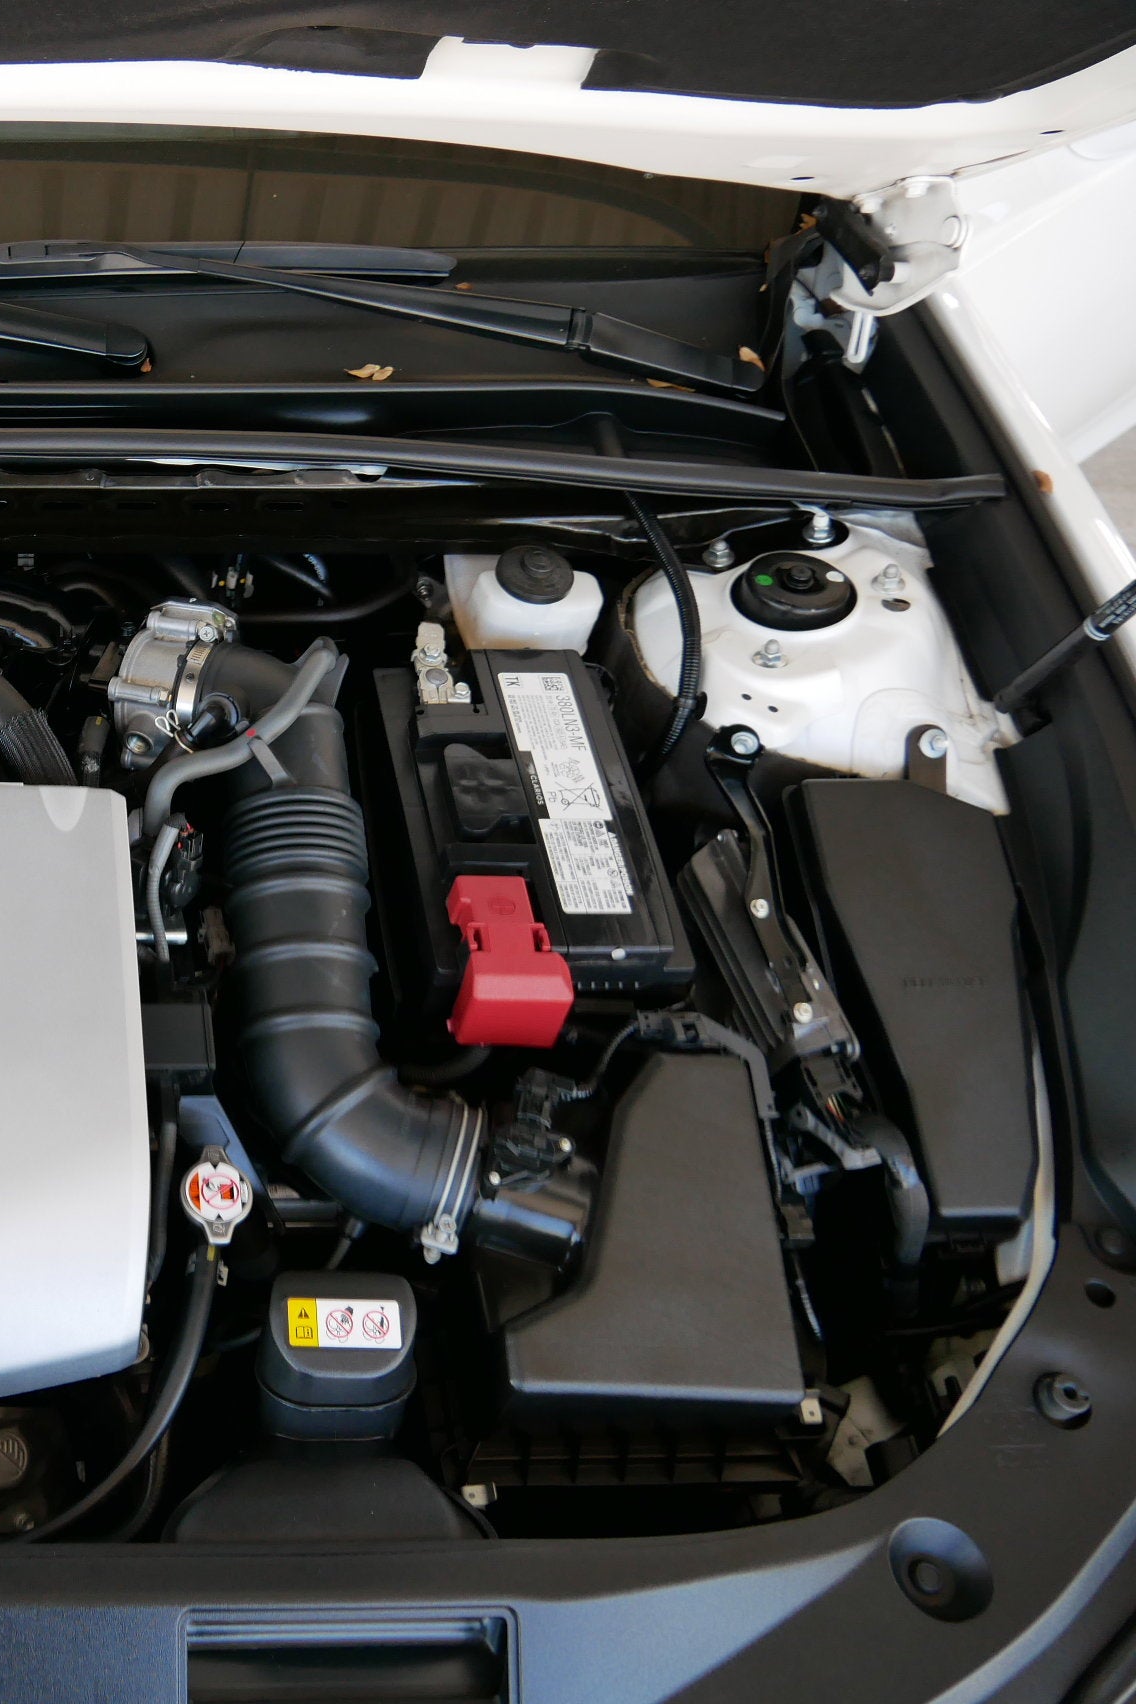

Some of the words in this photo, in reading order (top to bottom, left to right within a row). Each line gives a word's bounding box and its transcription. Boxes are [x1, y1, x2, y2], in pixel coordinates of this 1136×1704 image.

[505, 676, 520, 687] TK
[556, 695, 587, 751] 380LN3-MF
[530, 774, 545, 806] CLARIOS
[547, 790, 557, 803] Pb
